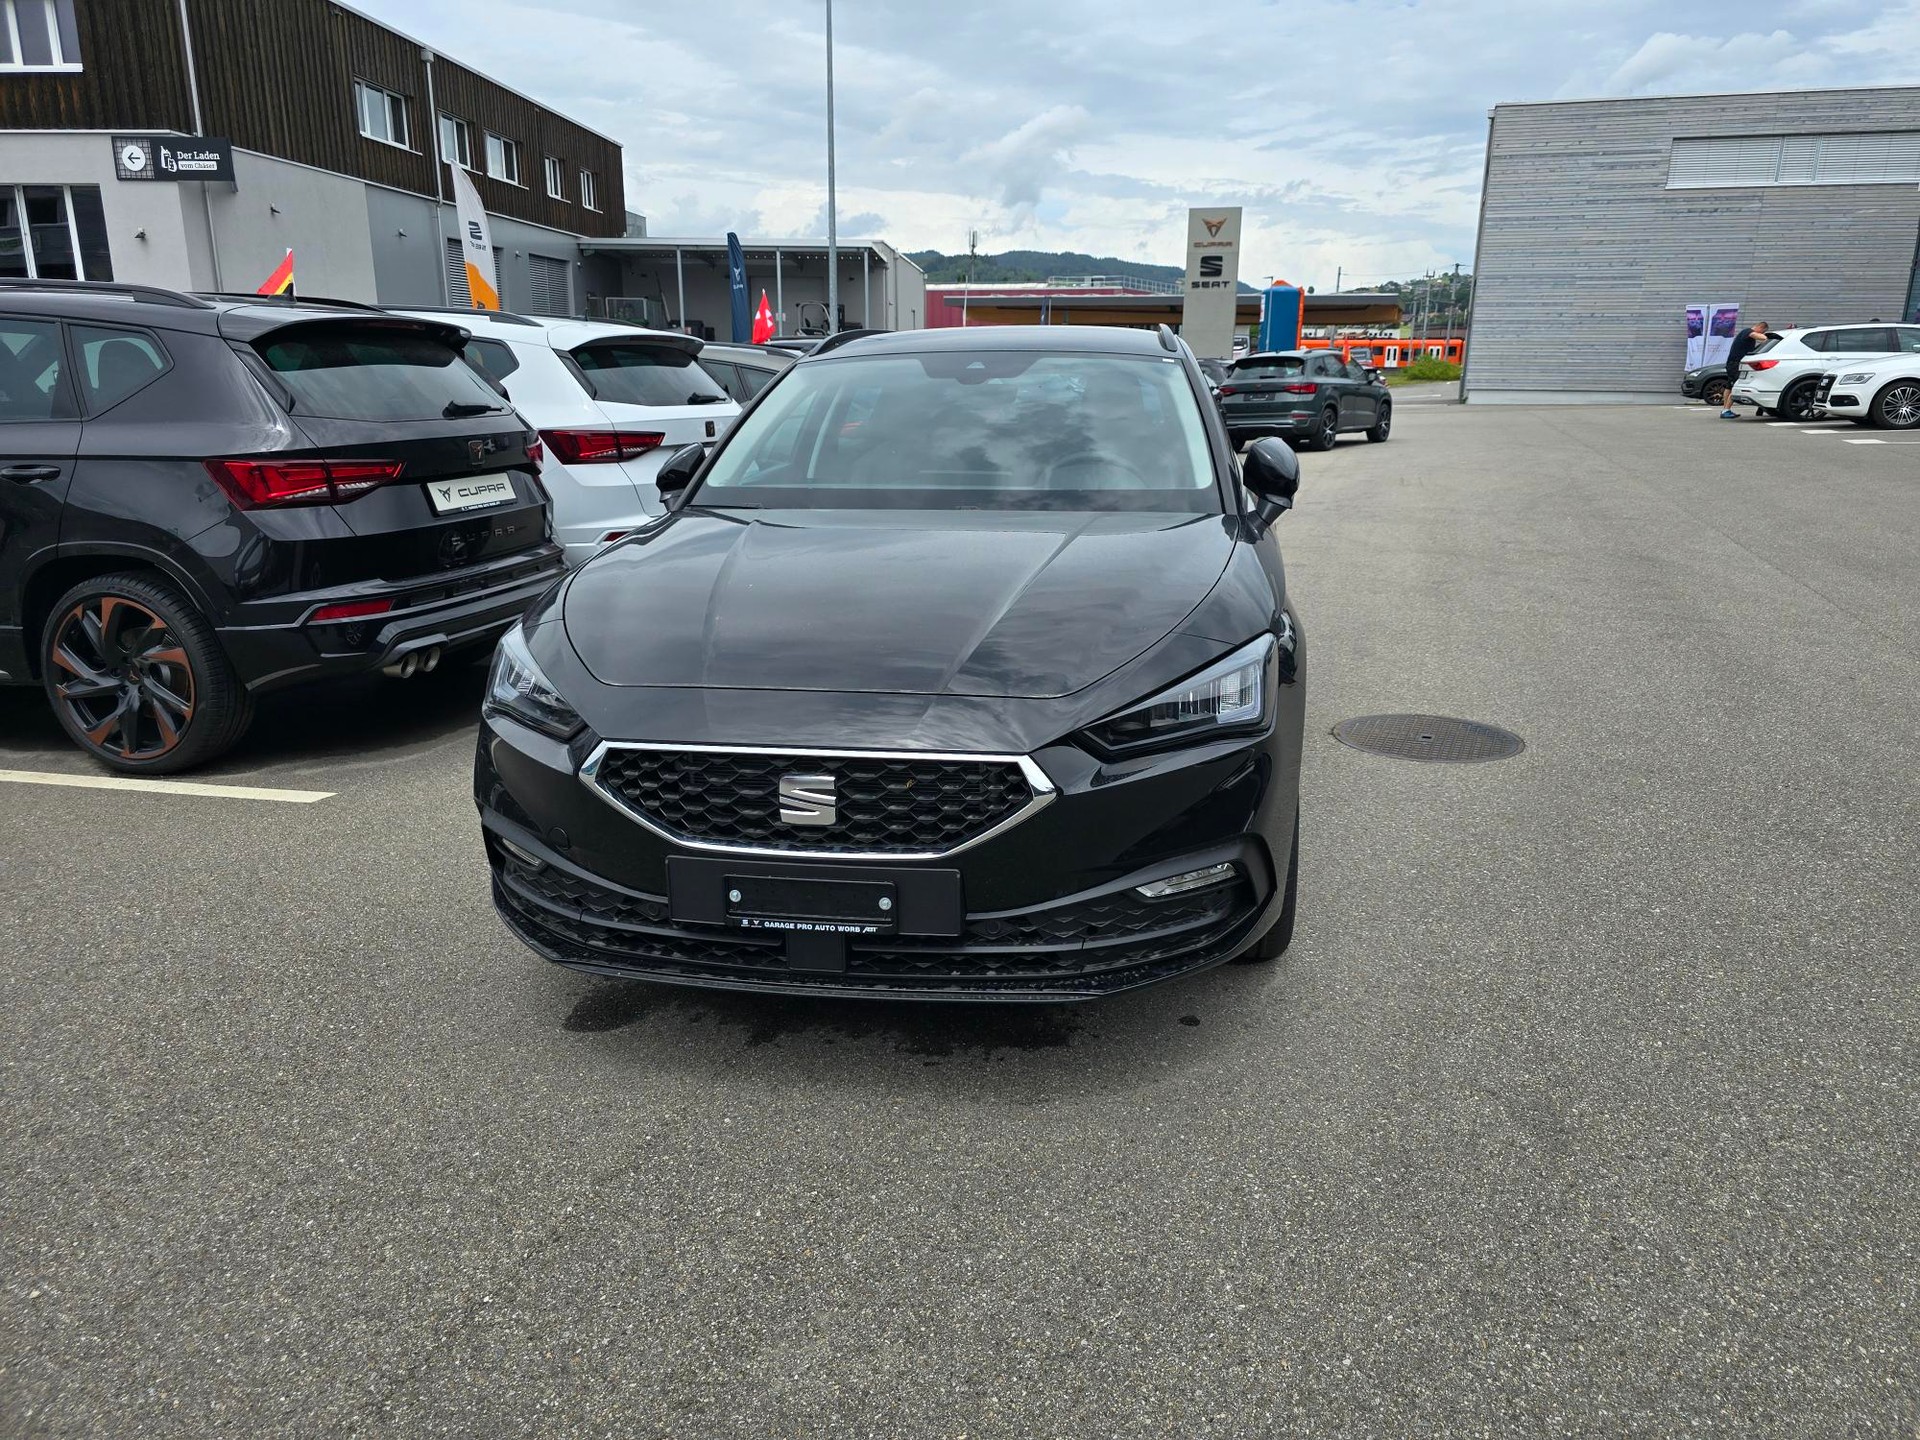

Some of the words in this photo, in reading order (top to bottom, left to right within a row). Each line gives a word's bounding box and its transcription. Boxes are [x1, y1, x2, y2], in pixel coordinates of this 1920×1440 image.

[177, 151, 192, 160] Der
[193, 151, 220, 160] Laden
[1191, 281, 1230, 289] SEAT
[457, 483, 506, 498] CUPRA
[763, 921, 795, 929] GARAGE
